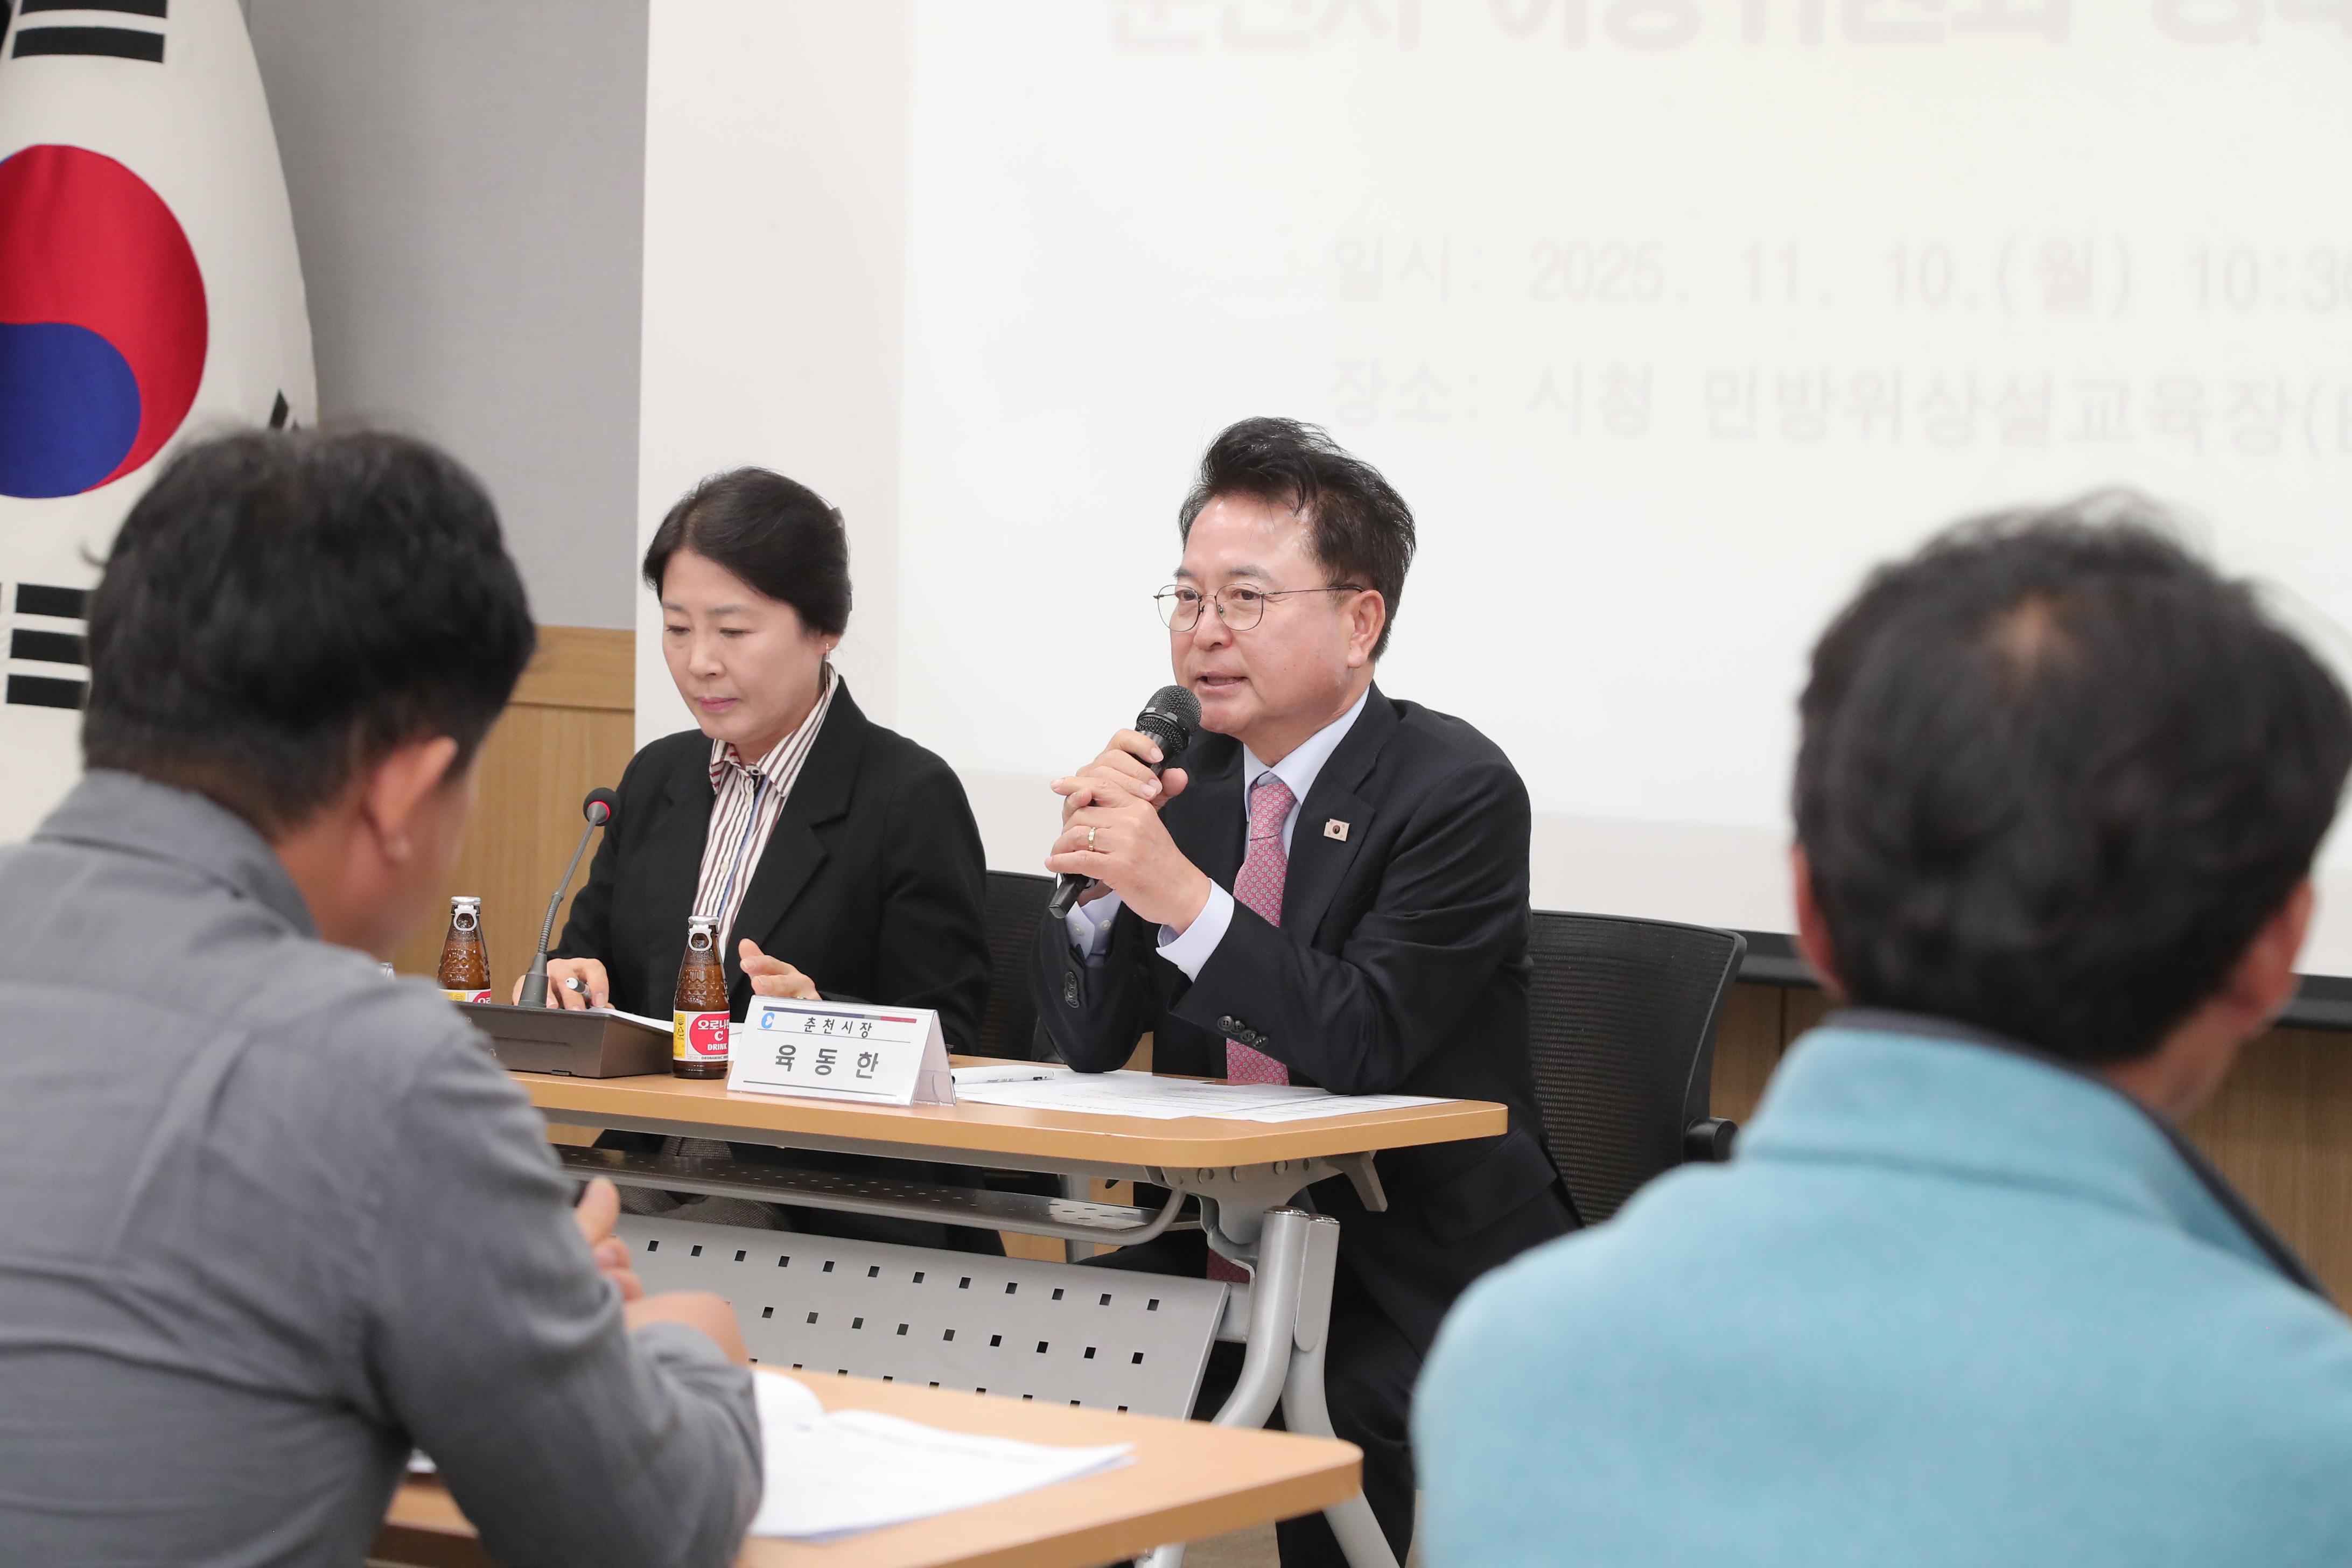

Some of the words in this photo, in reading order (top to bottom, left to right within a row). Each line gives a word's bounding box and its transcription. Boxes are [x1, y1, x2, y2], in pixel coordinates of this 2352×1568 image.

[1334, 230, 1484, 306] 일시:
[1527, 236, 1688, 306] 2025.
[1741, 237, 1831, 306] 11.
[2187, 242, 2352, 314] 10:3
[1328, 355, 1480, 428] 장소:
[1525, 359, 1654, 437] 시청
[714, 1031, 724, 1041] C
[804, 1017, 872, 1039] 춘천시장
[775, 1044, 879, 1079] 육동한
